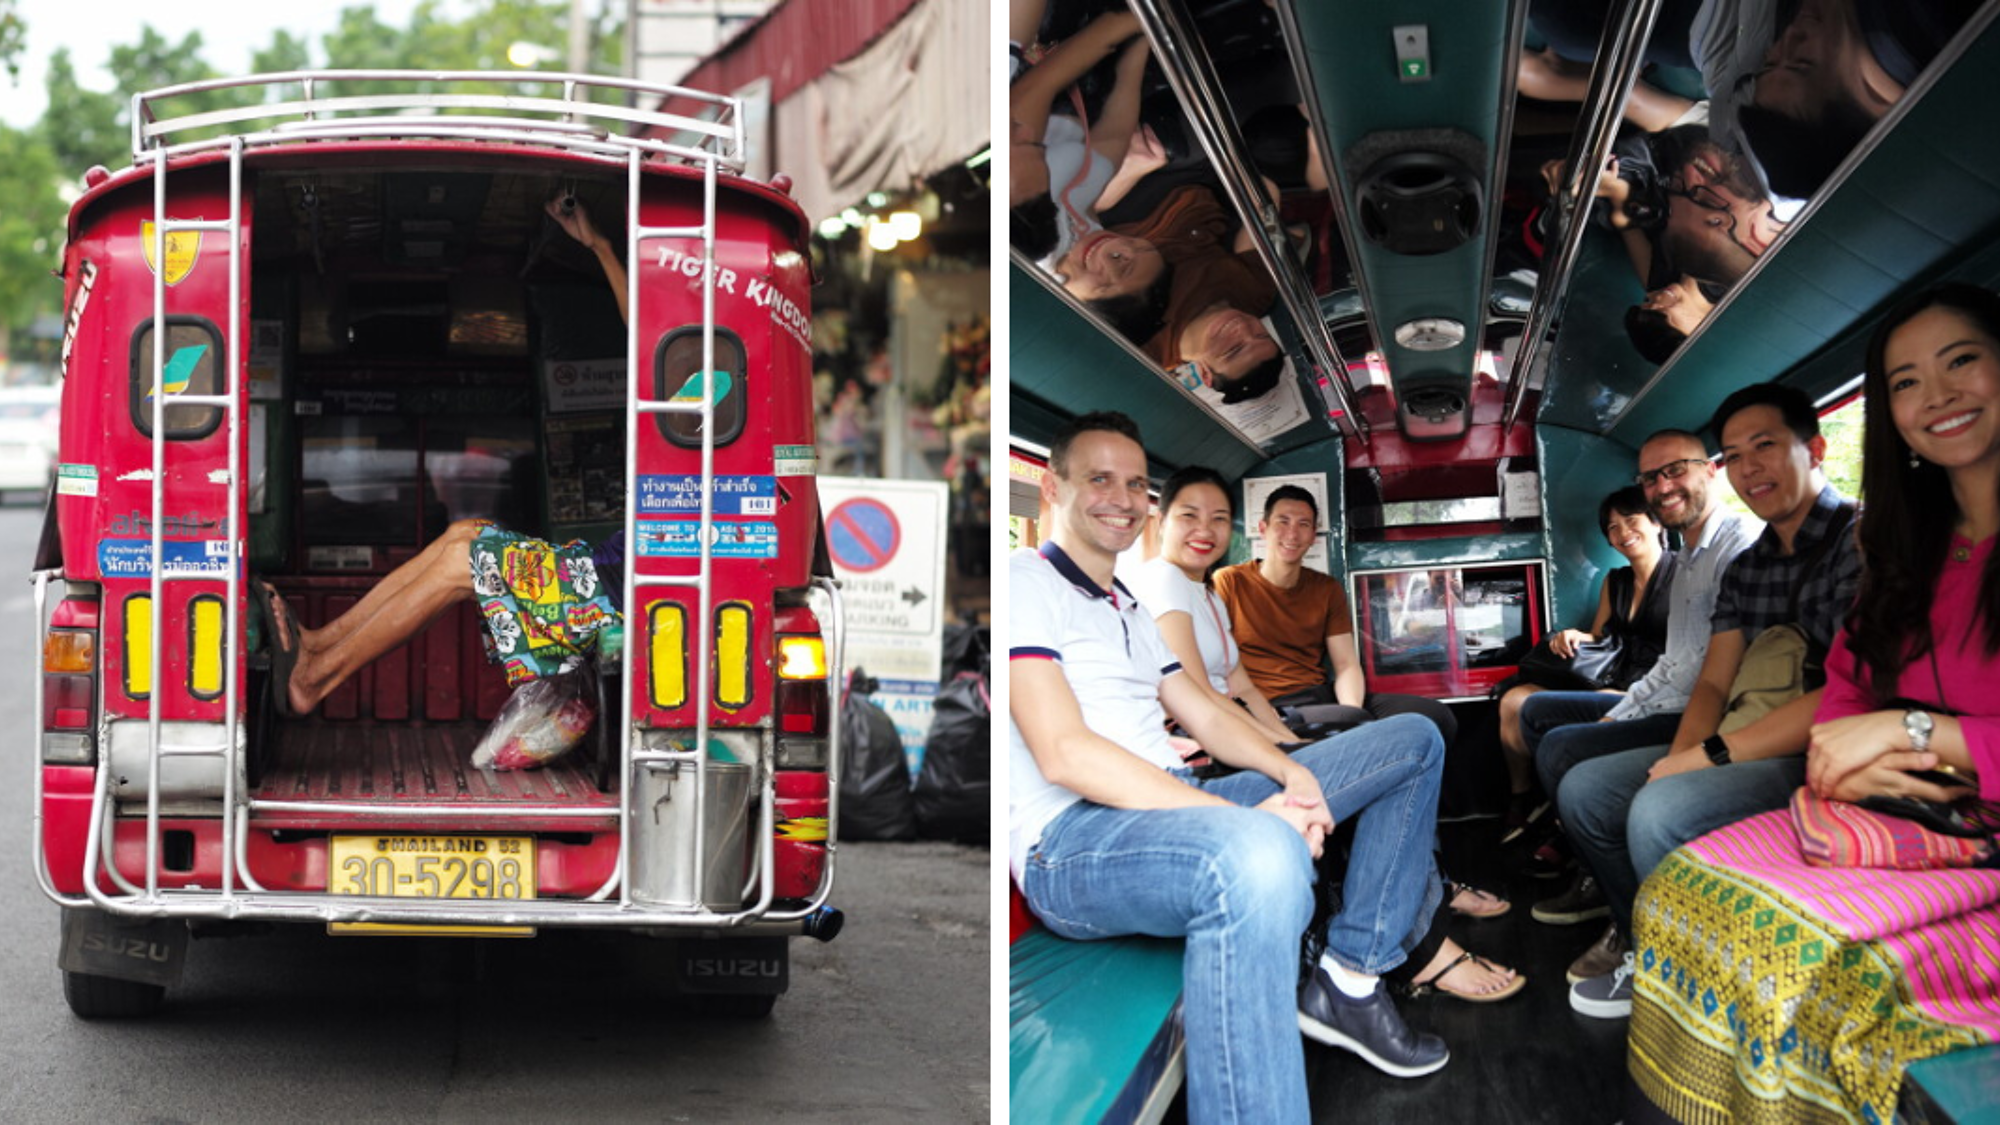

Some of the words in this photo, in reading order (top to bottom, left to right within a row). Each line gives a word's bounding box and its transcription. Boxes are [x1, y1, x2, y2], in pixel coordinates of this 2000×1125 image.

[637, 523, 679, 532] WELCOME
[684, 524, 696, 532] TO
[845, 613, 909, 628] ARKING
[375, 838, 488, 853] THAILAND
[499, 839, 521, 854] 52
[342, 856, 521, 899] 30-5298
[687, 959, 779, 977] ISUZU
